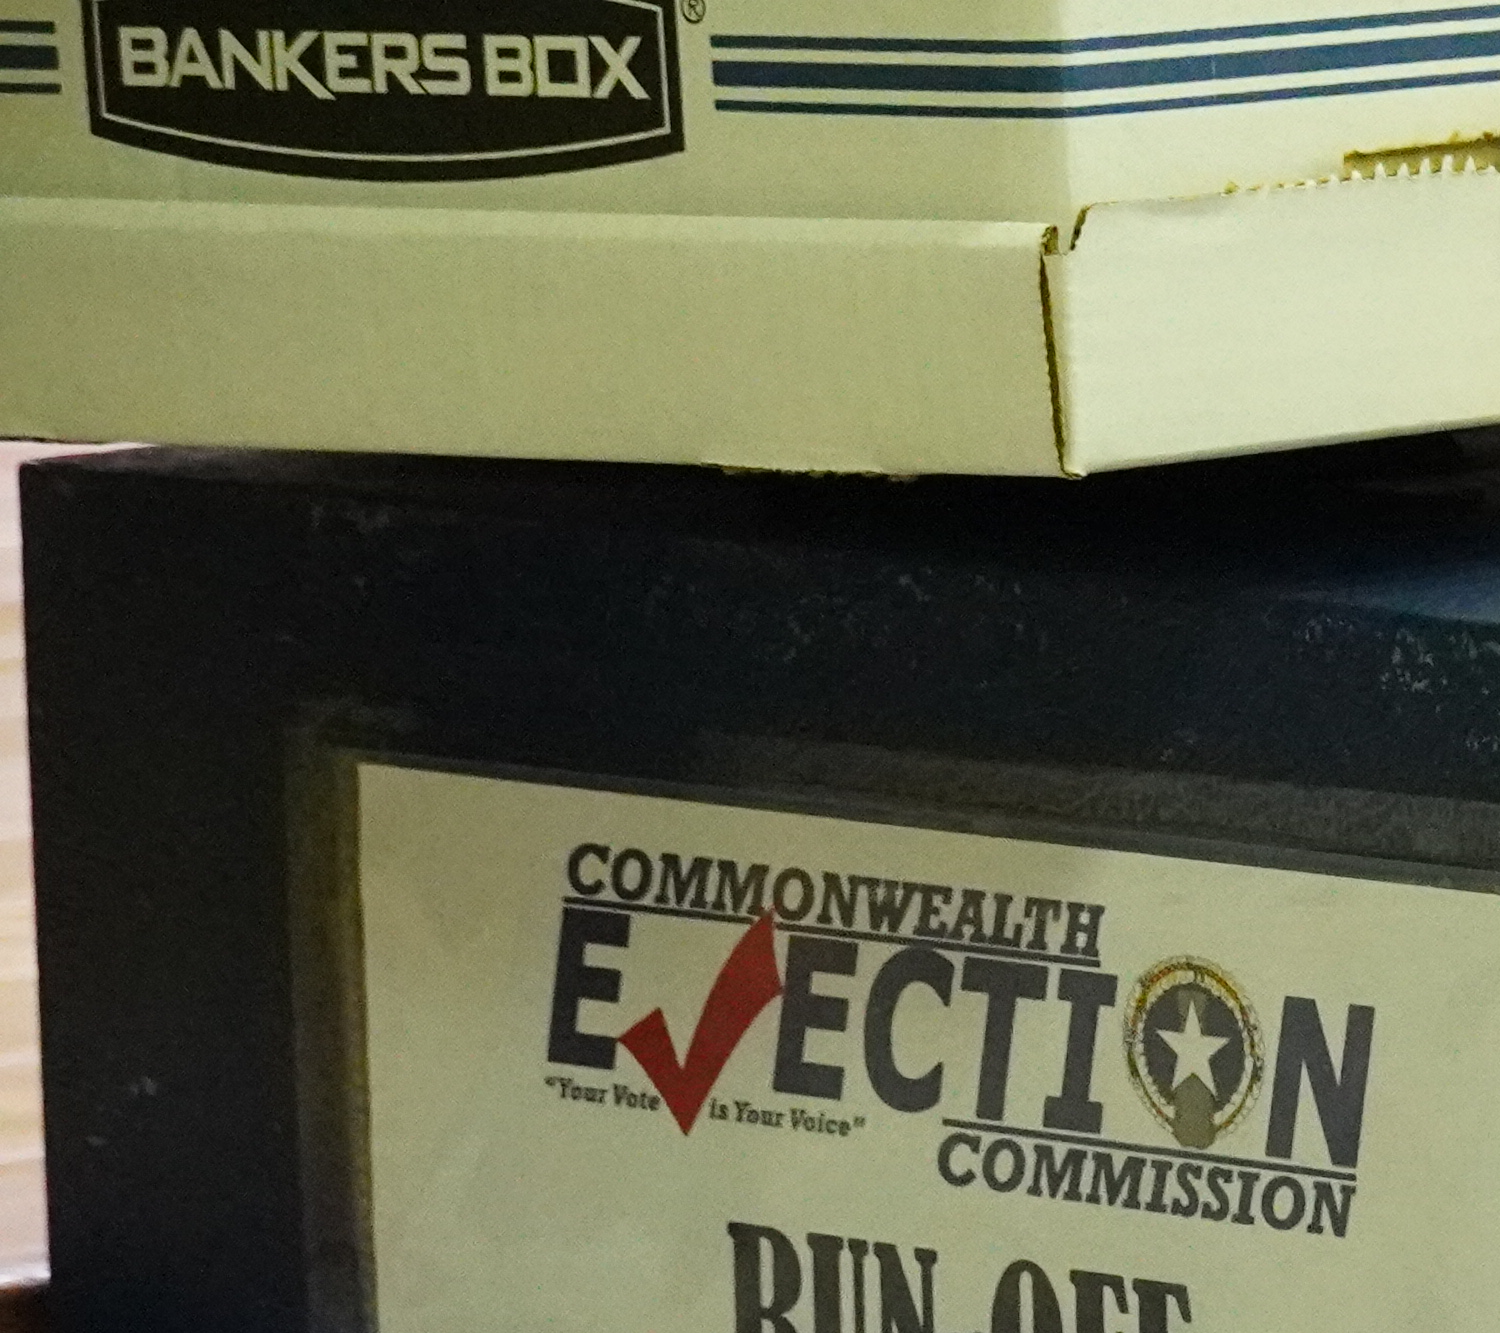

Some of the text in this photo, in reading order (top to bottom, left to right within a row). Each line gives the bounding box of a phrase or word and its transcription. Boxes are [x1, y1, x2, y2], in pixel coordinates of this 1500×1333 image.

[119, 27, 649, 99] BANKERS BOX
[566, 842, 1105, 957] COMMONWEALTH
[612, 1083, 661, 1111] Vote
[734, 1100, 785, 1128] Your
[936, 1132, 1357, 1238] COMMISSION
